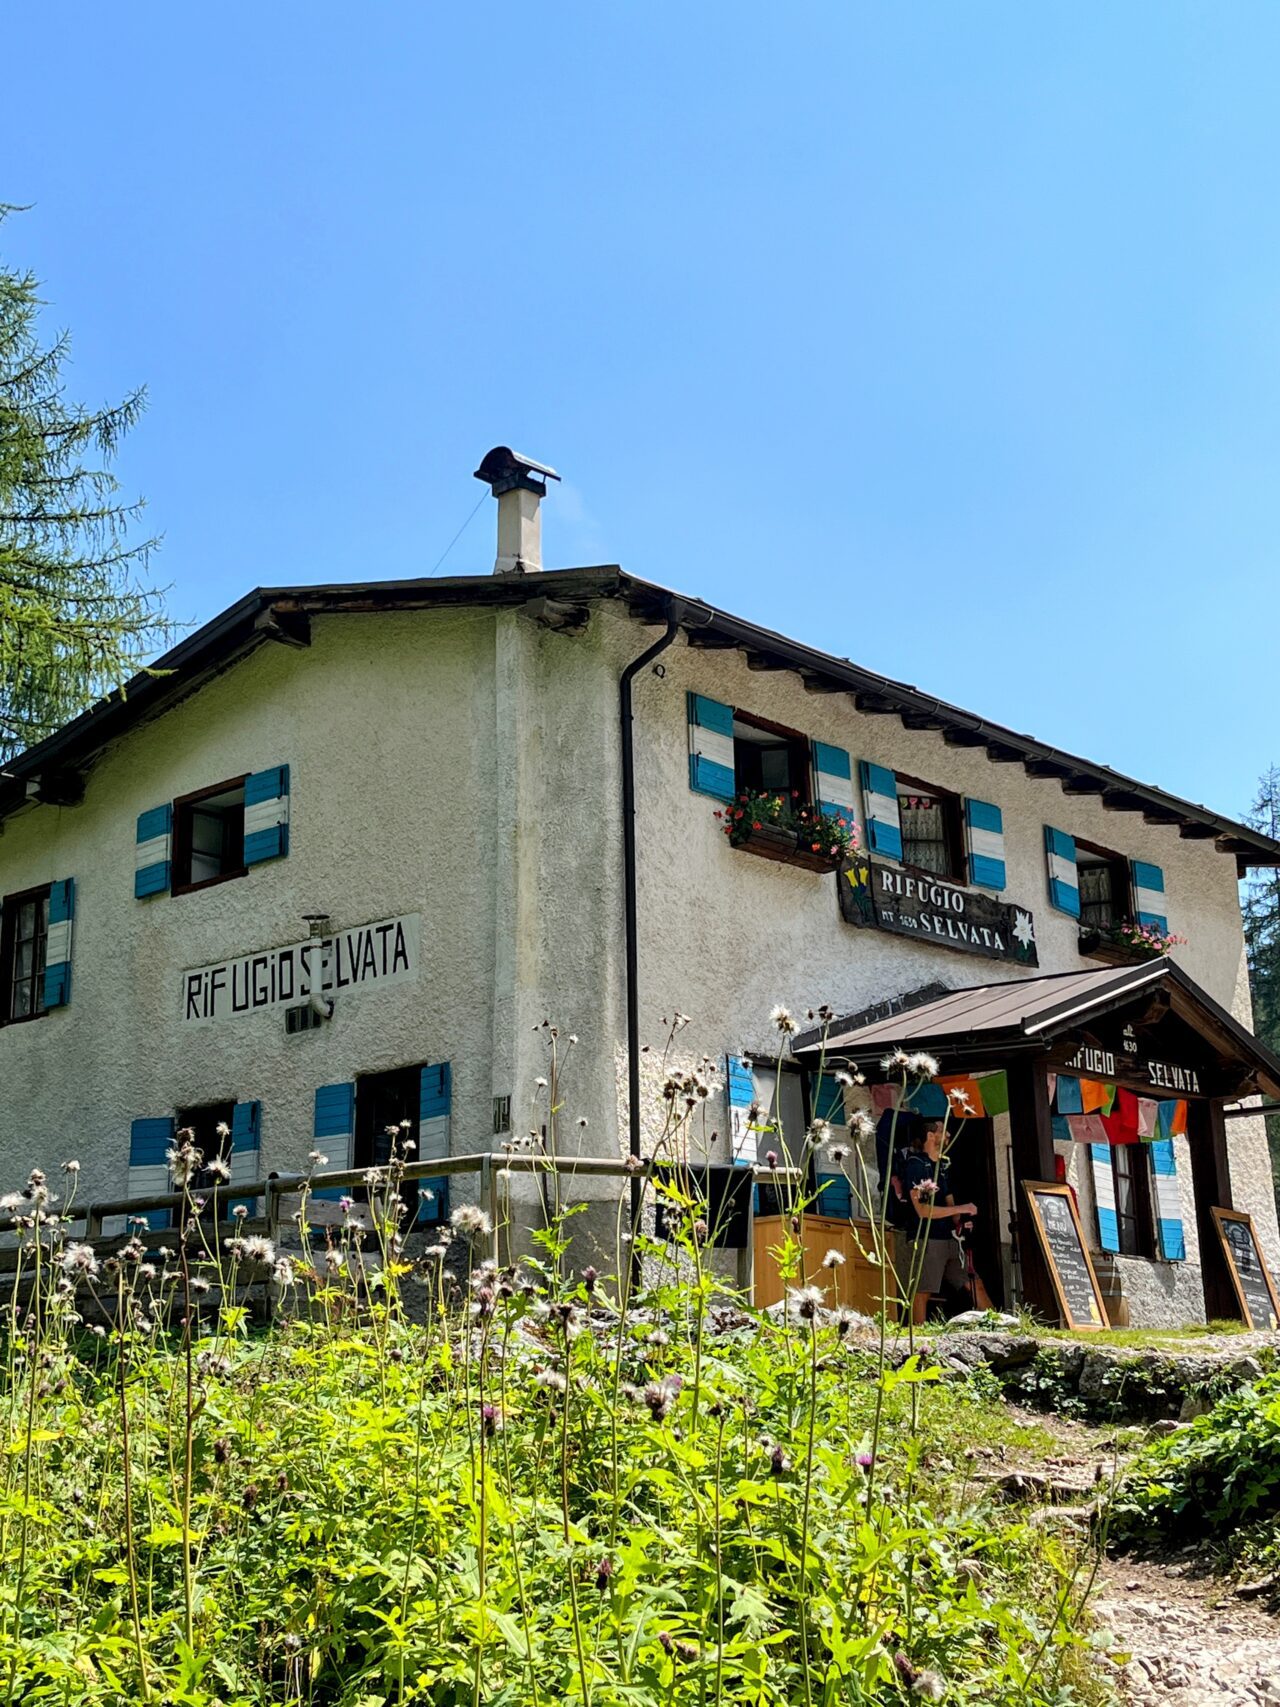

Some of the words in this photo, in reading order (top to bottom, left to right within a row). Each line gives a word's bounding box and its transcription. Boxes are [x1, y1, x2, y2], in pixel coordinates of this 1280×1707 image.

[881, 870, 965, 913] RIFUGIO
[899, 914, 918, 929] 1630
[919, 912, 1005, 950] SELVATA
[1148, 1061, 1200, 1093] SELVATA
